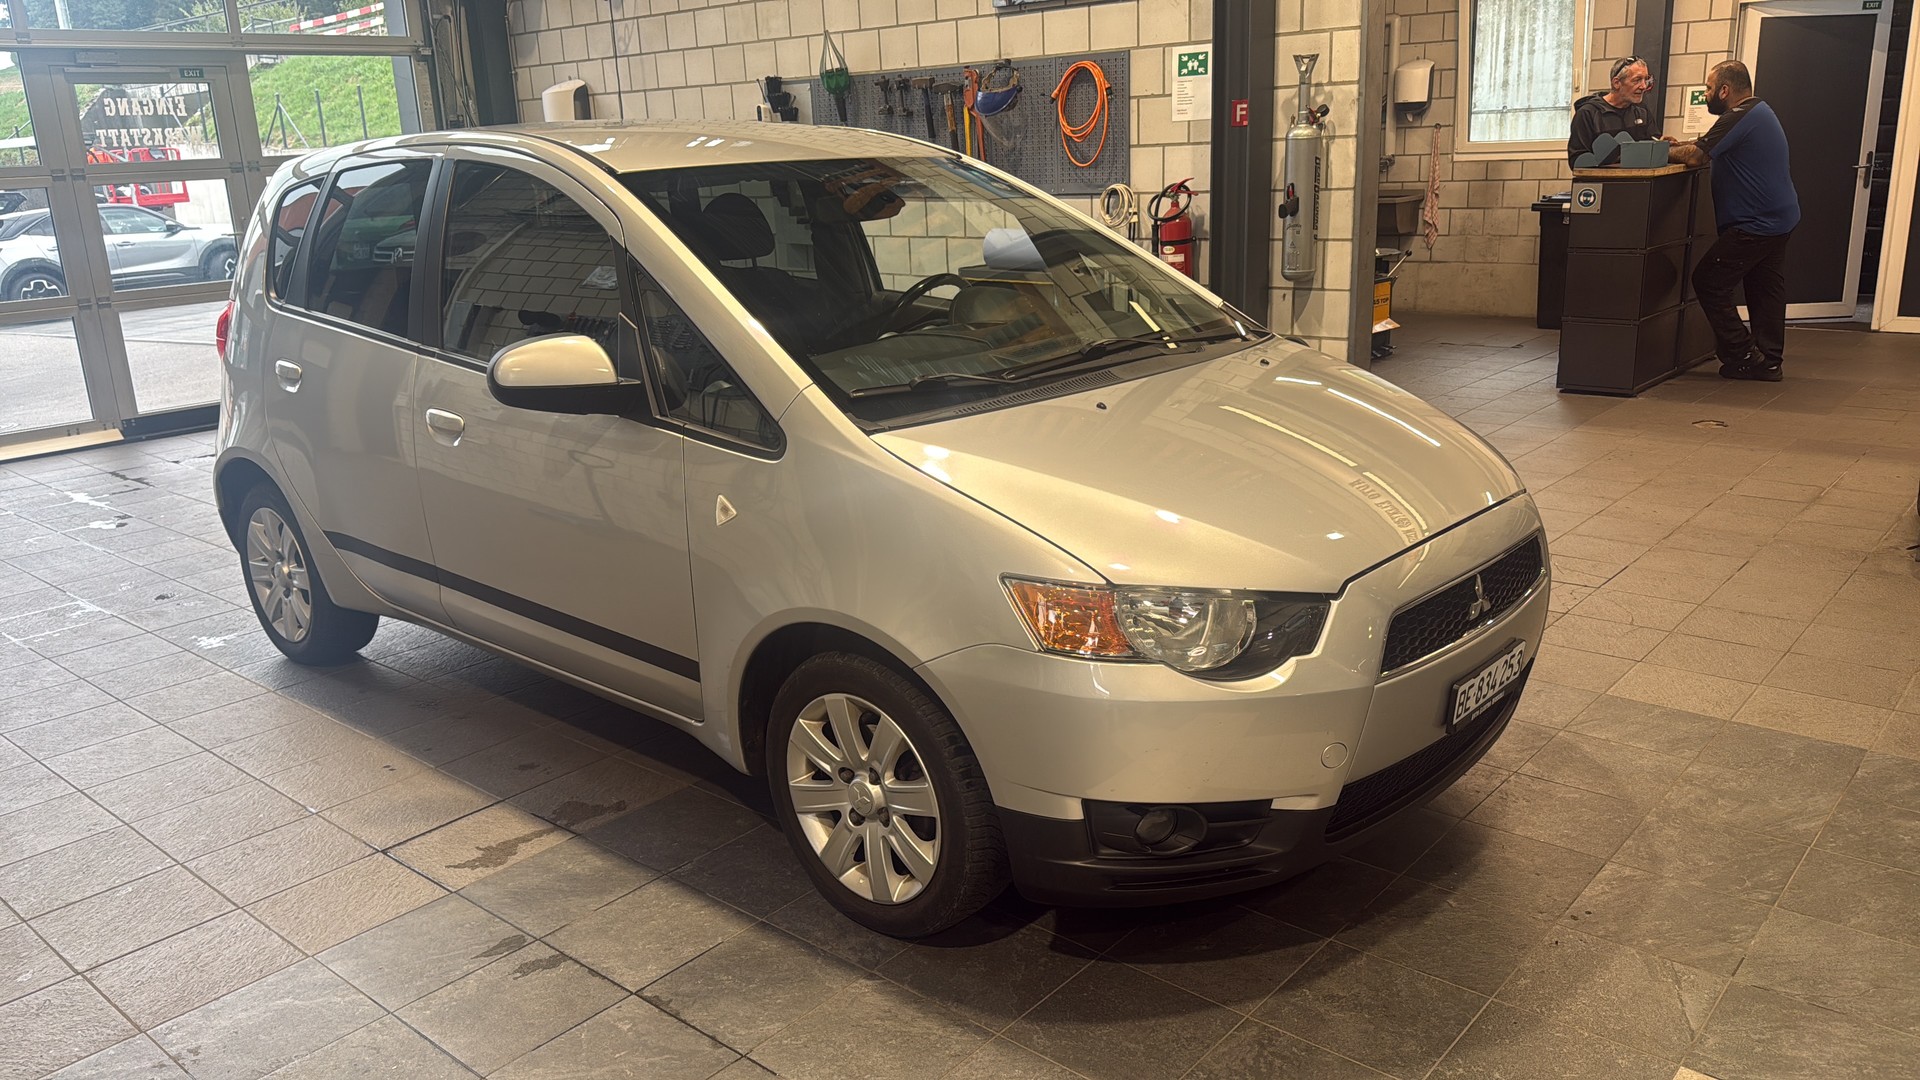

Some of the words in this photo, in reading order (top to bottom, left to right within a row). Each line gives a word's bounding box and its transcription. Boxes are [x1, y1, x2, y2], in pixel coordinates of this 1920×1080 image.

[184, 69, 200, 77] EXIT
[1236, 104, 1248, 122] F
[1499, 649, 1523, 688] 253
